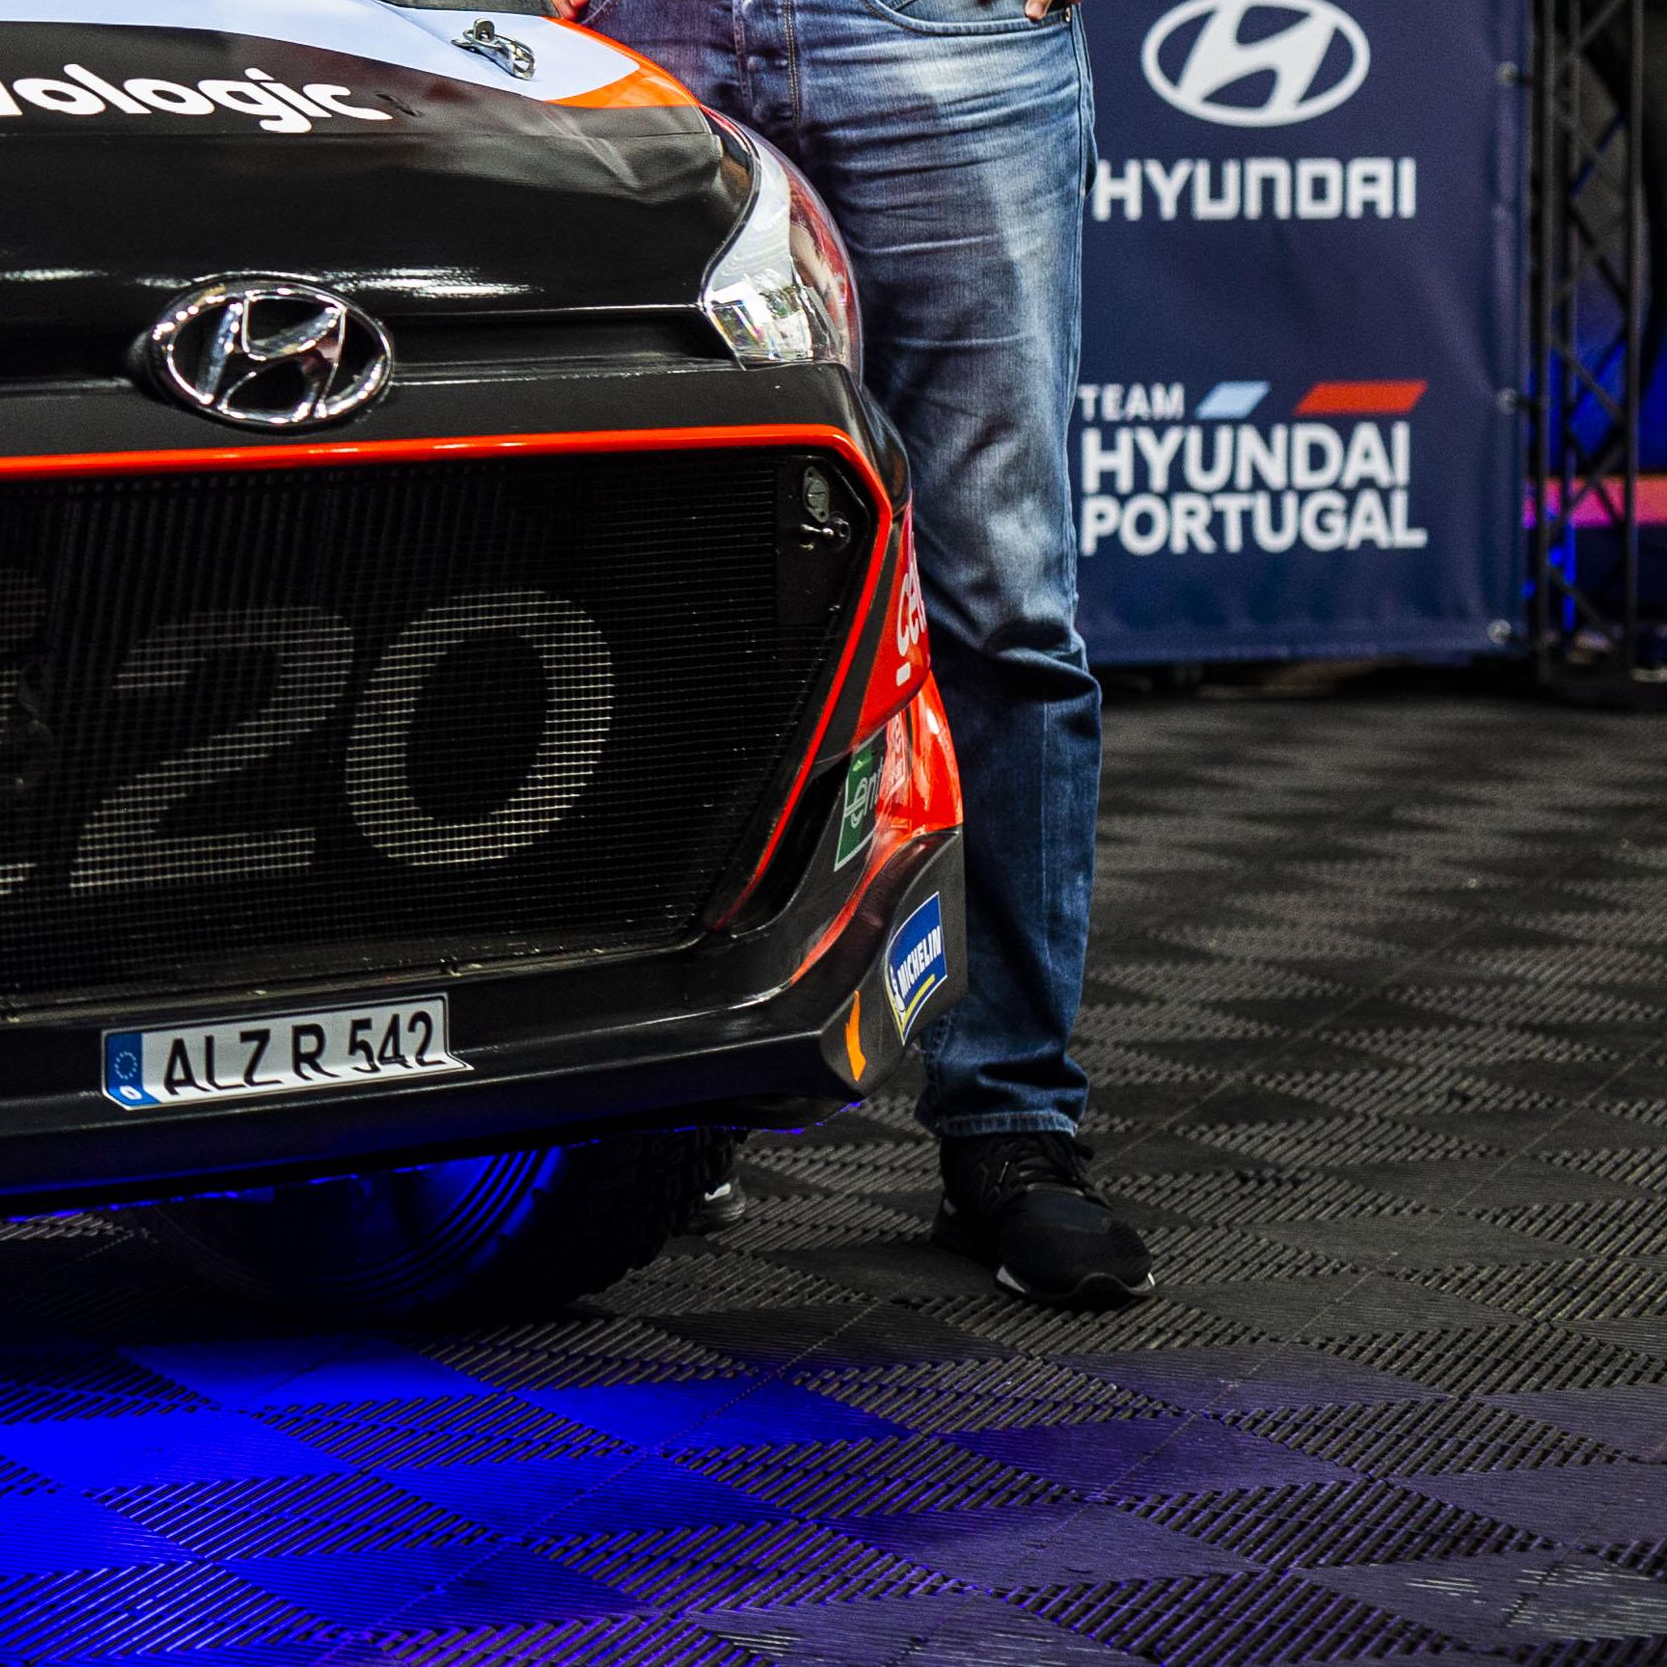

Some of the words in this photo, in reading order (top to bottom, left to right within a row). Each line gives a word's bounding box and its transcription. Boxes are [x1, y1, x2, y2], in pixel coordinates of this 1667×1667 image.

[1093, 157, 1416, 221] HYUNDAI
[1078, 383, 1184, 421] TEAM
[1082, 422, 1410, 492] HYUNDAI
[1081, 491, 1427, 557] PORTUGAL
[896, 925, 942, 984] MICHELIN
[164, 1028, 283, 1096] ALZ
[292, 1023, 341, 1081] R
[347, 1010, 447, 1074] 542
